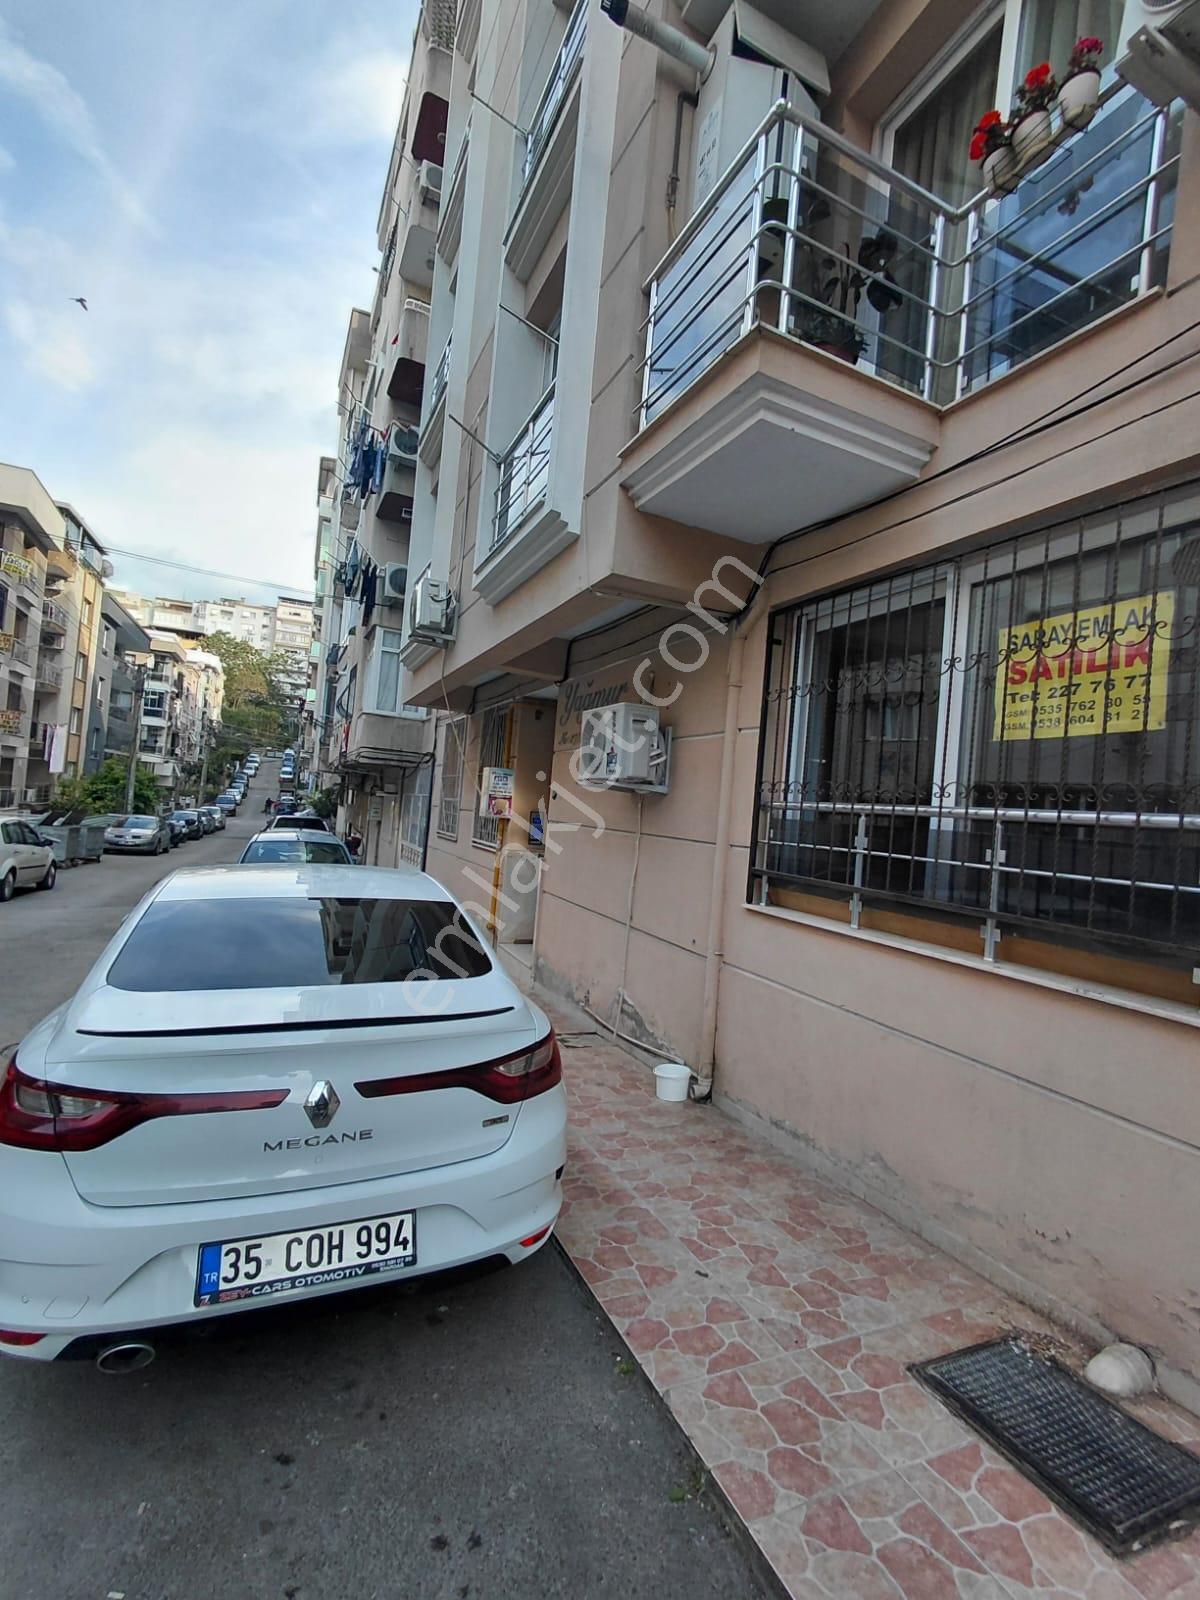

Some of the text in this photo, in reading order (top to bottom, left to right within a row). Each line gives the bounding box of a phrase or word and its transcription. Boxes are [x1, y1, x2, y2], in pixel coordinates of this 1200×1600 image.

[1008, 639, 1151, 685] SATILIK
[1047, 683, 1081, 699] 227
[1070, 700, 1096, 712] 762
[1069, 714, 1095, 725] 604
[263, 1129, 374, 1152] MEGANE
[204, 1218, 410, 1284] TR 35 COH 994
